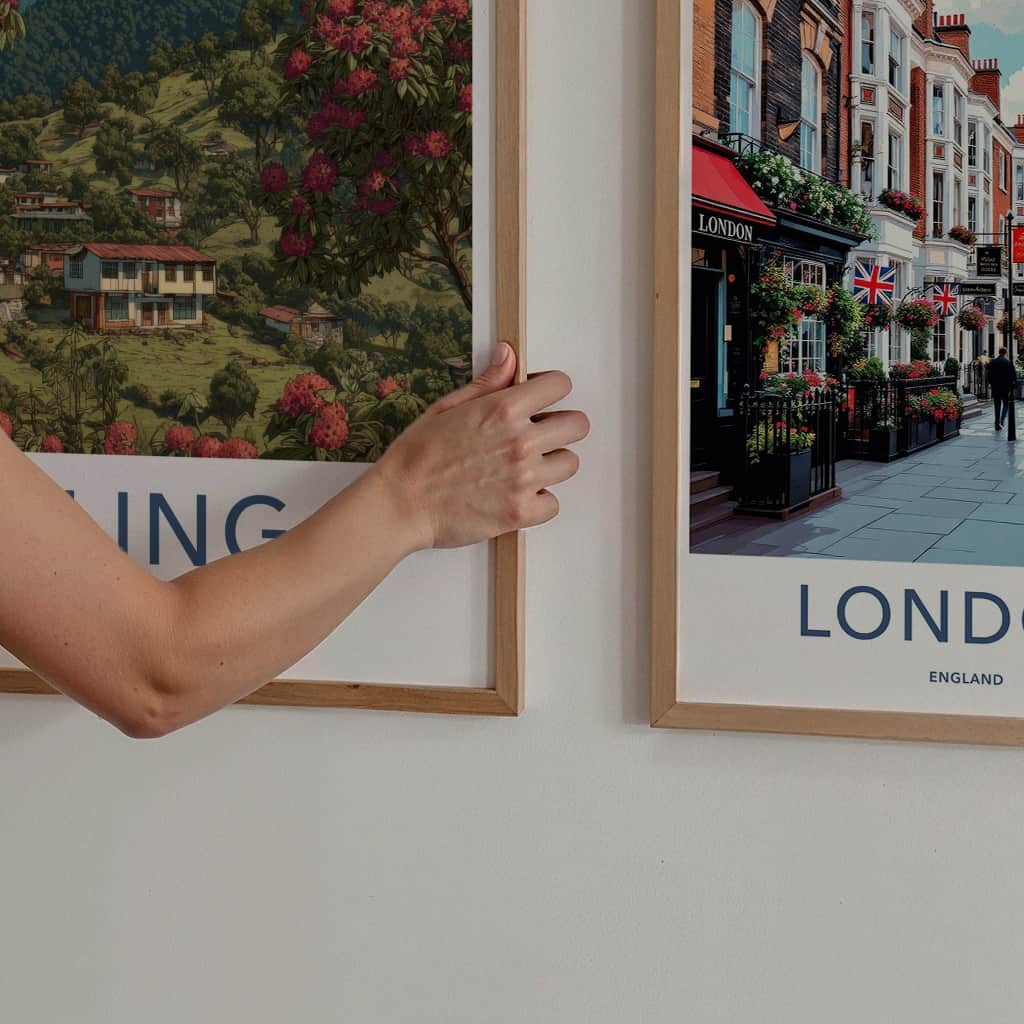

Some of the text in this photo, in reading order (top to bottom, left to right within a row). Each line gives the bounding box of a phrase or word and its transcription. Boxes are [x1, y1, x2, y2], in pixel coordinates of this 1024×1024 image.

[699, 213, 753, 242] LONDON
[800, 584, 1024, 645] LOND
[929, 671, 1004, 686] ENGLAND
